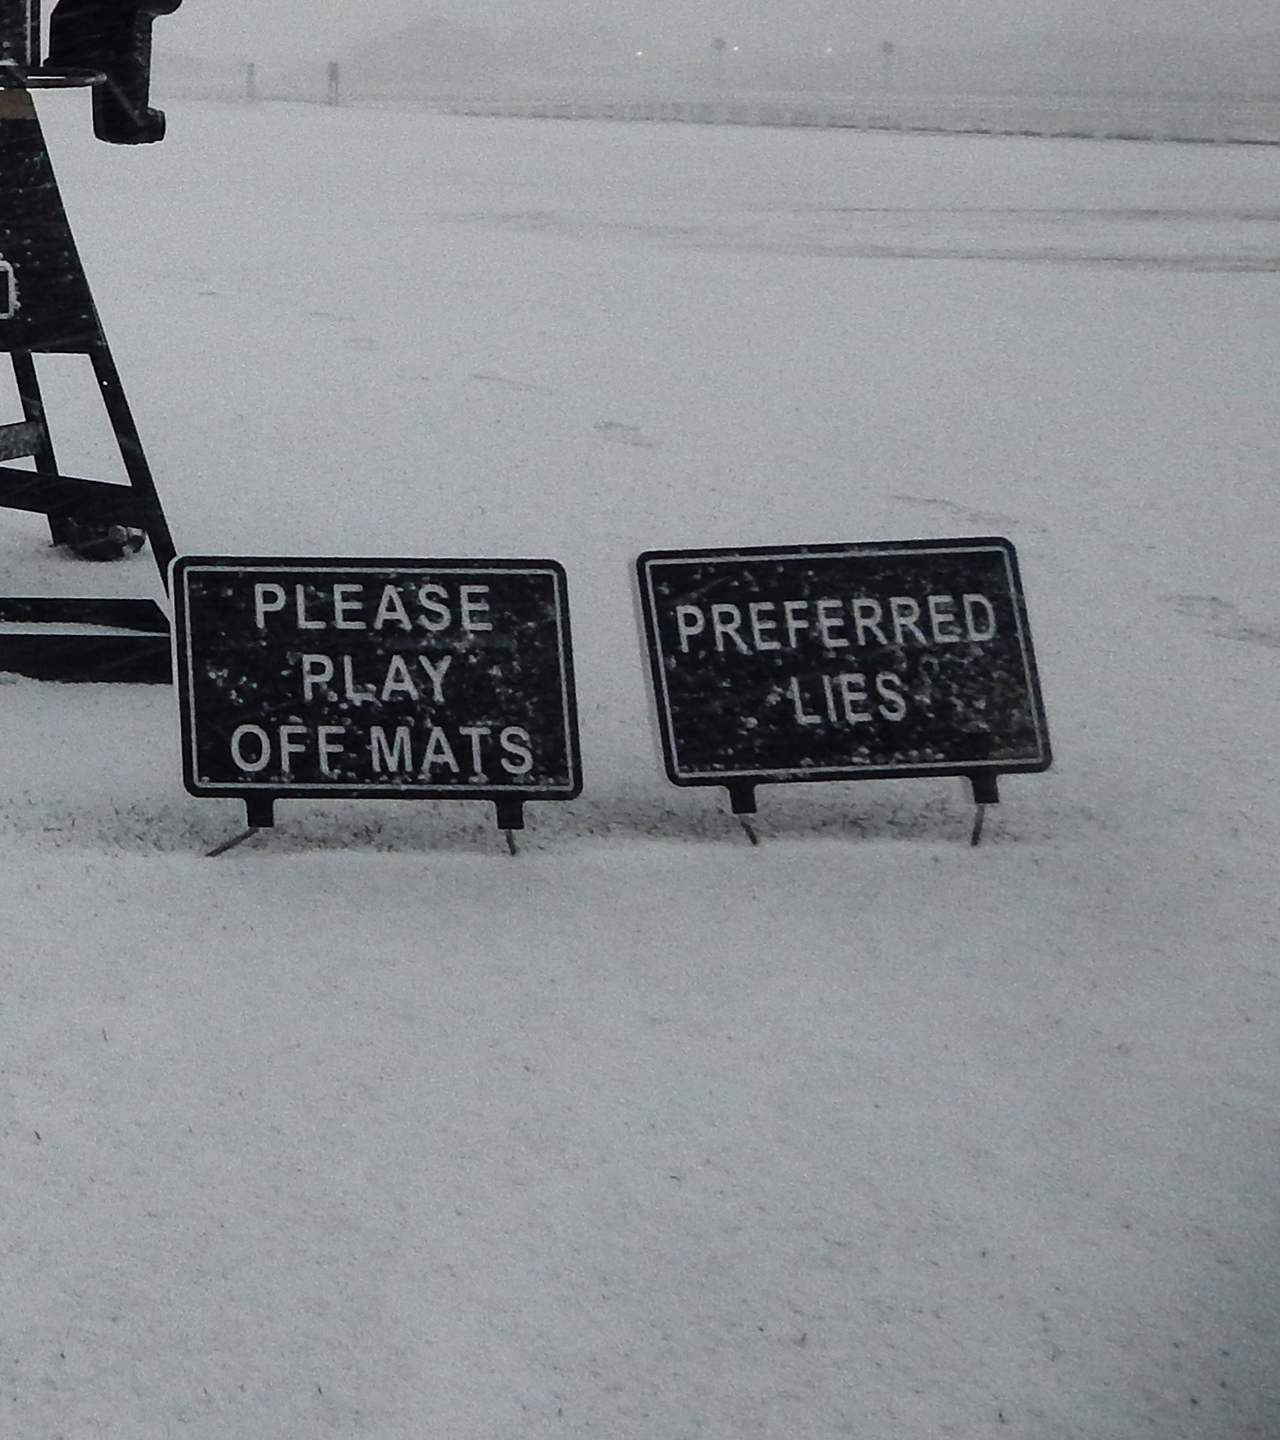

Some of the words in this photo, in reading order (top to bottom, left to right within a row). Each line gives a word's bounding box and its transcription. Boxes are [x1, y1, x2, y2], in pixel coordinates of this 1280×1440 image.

[253, 582, 494, 632] PLEASE
[675, 592, 998, 656] PREFERRED
[302, 653, 453, 703] PLAY
[790, 671, 909, 726] LIES
[230, 724, 346, 775] OFF
[370, 725, 535, 776] MATS
